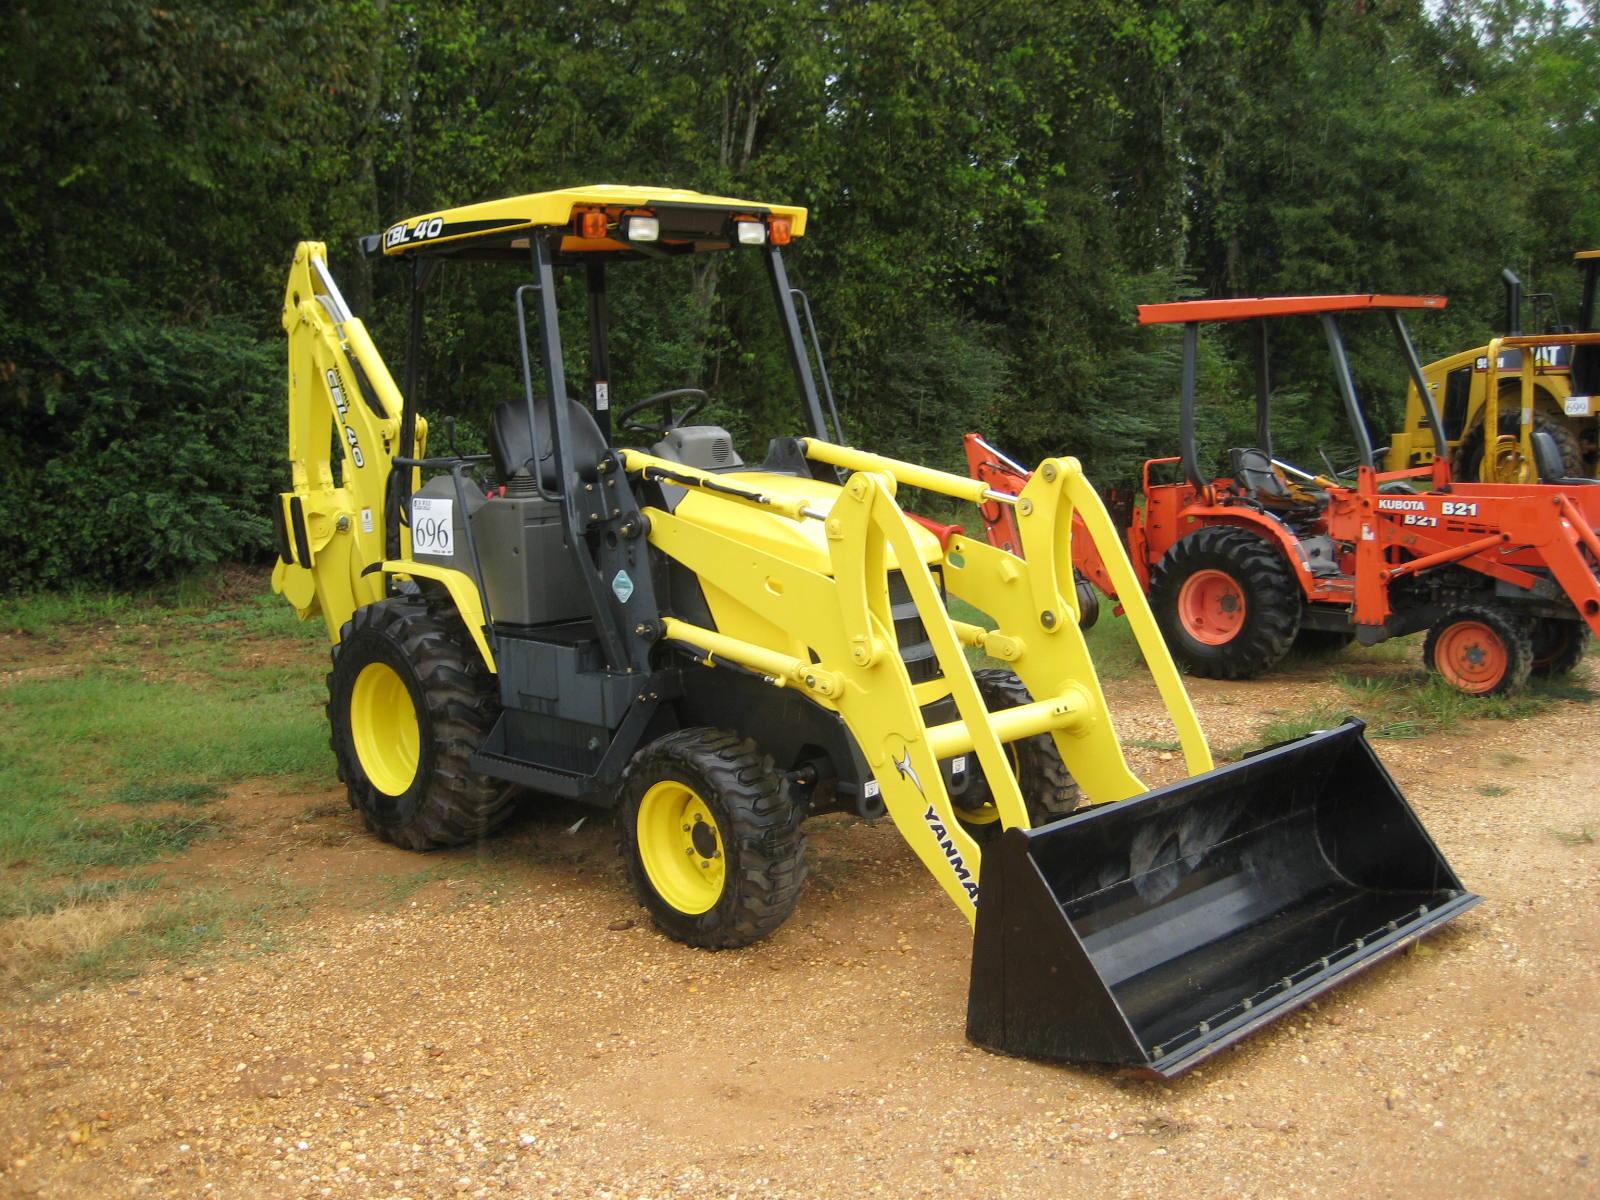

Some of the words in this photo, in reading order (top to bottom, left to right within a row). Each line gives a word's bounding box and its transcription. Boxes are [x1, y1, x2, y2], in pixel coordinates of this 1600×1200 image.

[386, 224, 411, 248] CBL
[413, 217, 443, 240] 40
[1531, 345, 1560, 367] AT
[345, 426, 365, 468] 40
[1378, 499, 1425, 511] KUBOTA
[1441, 502, 1478, 516] B21
[1404, 514, 1438, 527] B21
[416, 517, 449, 549] 696
